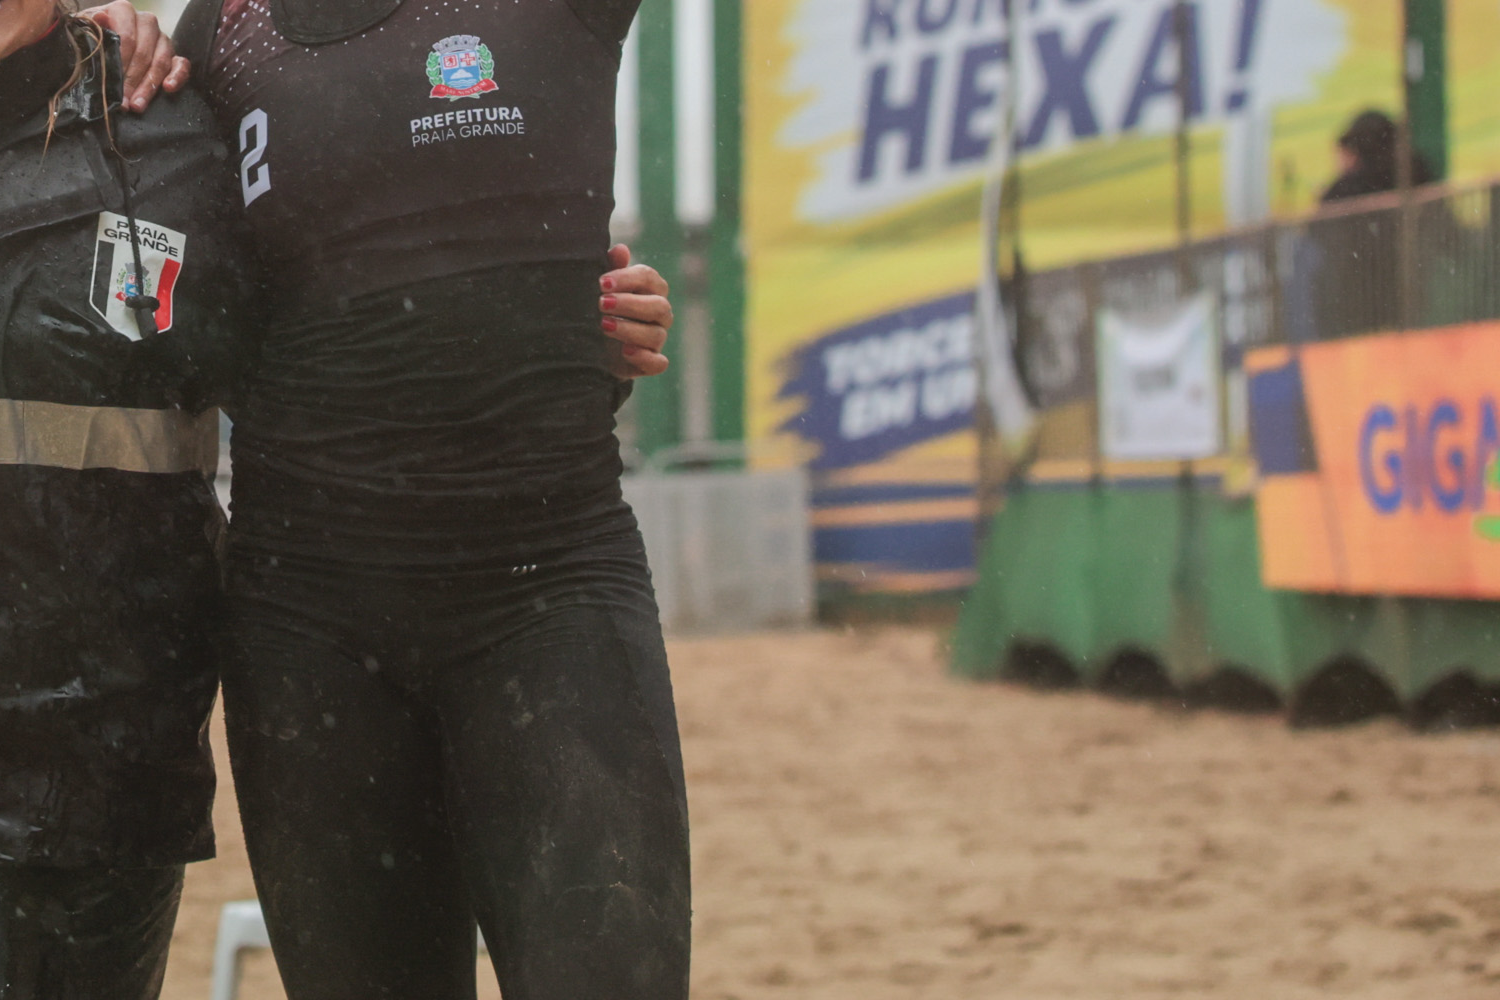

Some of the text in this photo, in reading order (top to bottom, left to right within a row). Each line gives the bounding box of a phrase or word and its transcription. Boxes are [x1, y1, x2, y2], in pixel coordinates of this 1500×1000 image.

[410, 106, 524, 134] PREFEITURA
[412, 122, 525, 147] PRAIA GRANDE
[239, 107, 271, 208] 2
